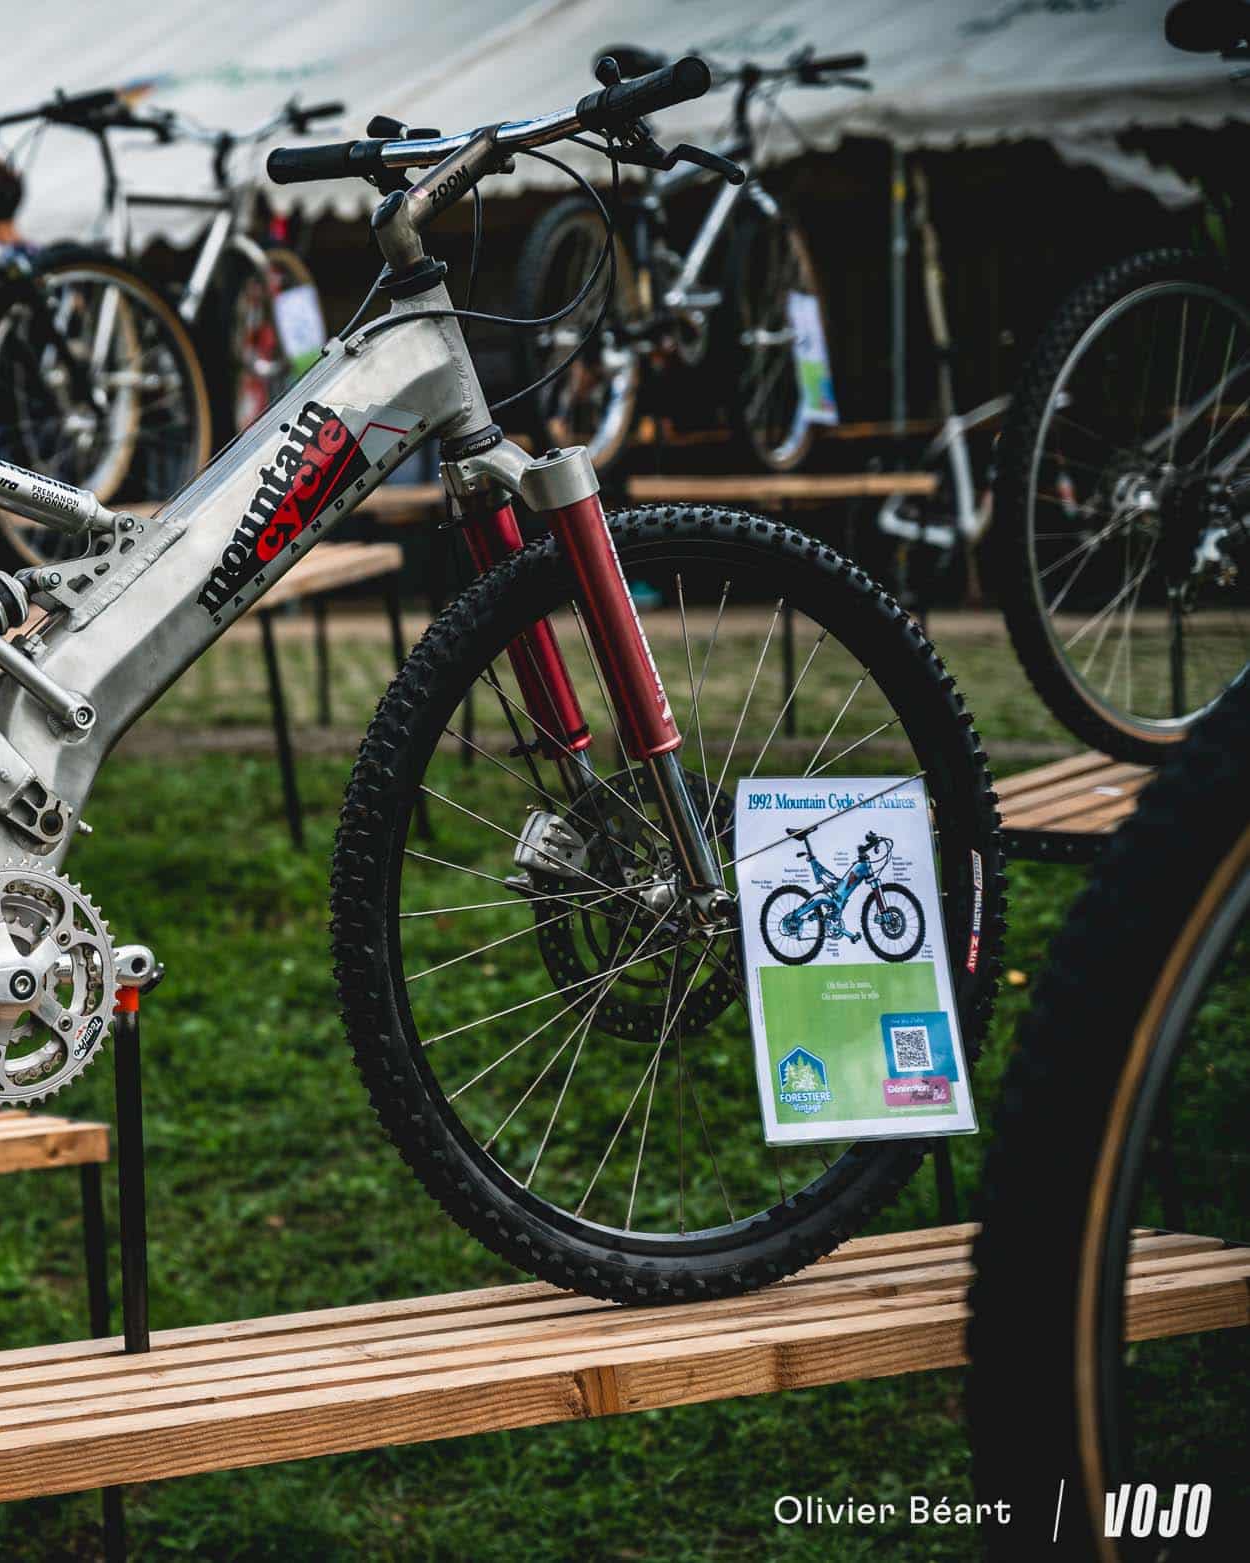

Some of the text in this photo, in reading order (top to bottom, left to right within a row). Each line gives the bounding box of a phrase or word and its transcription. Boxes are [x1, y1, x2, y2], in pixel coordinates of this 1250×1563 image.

[428, 164, 469, 207] ZOOM
[31, 484, 81, 509] PREMANON
[31, 492, 79, 514] OYONNAX
[256, 418, 348, 562] cycle
[196, 401, 338, 617] mountain
[748, 793, 771, 810] 1992
[775, 793, 826, 810] Mountain
[828, 792, 855, 812] Cycle
